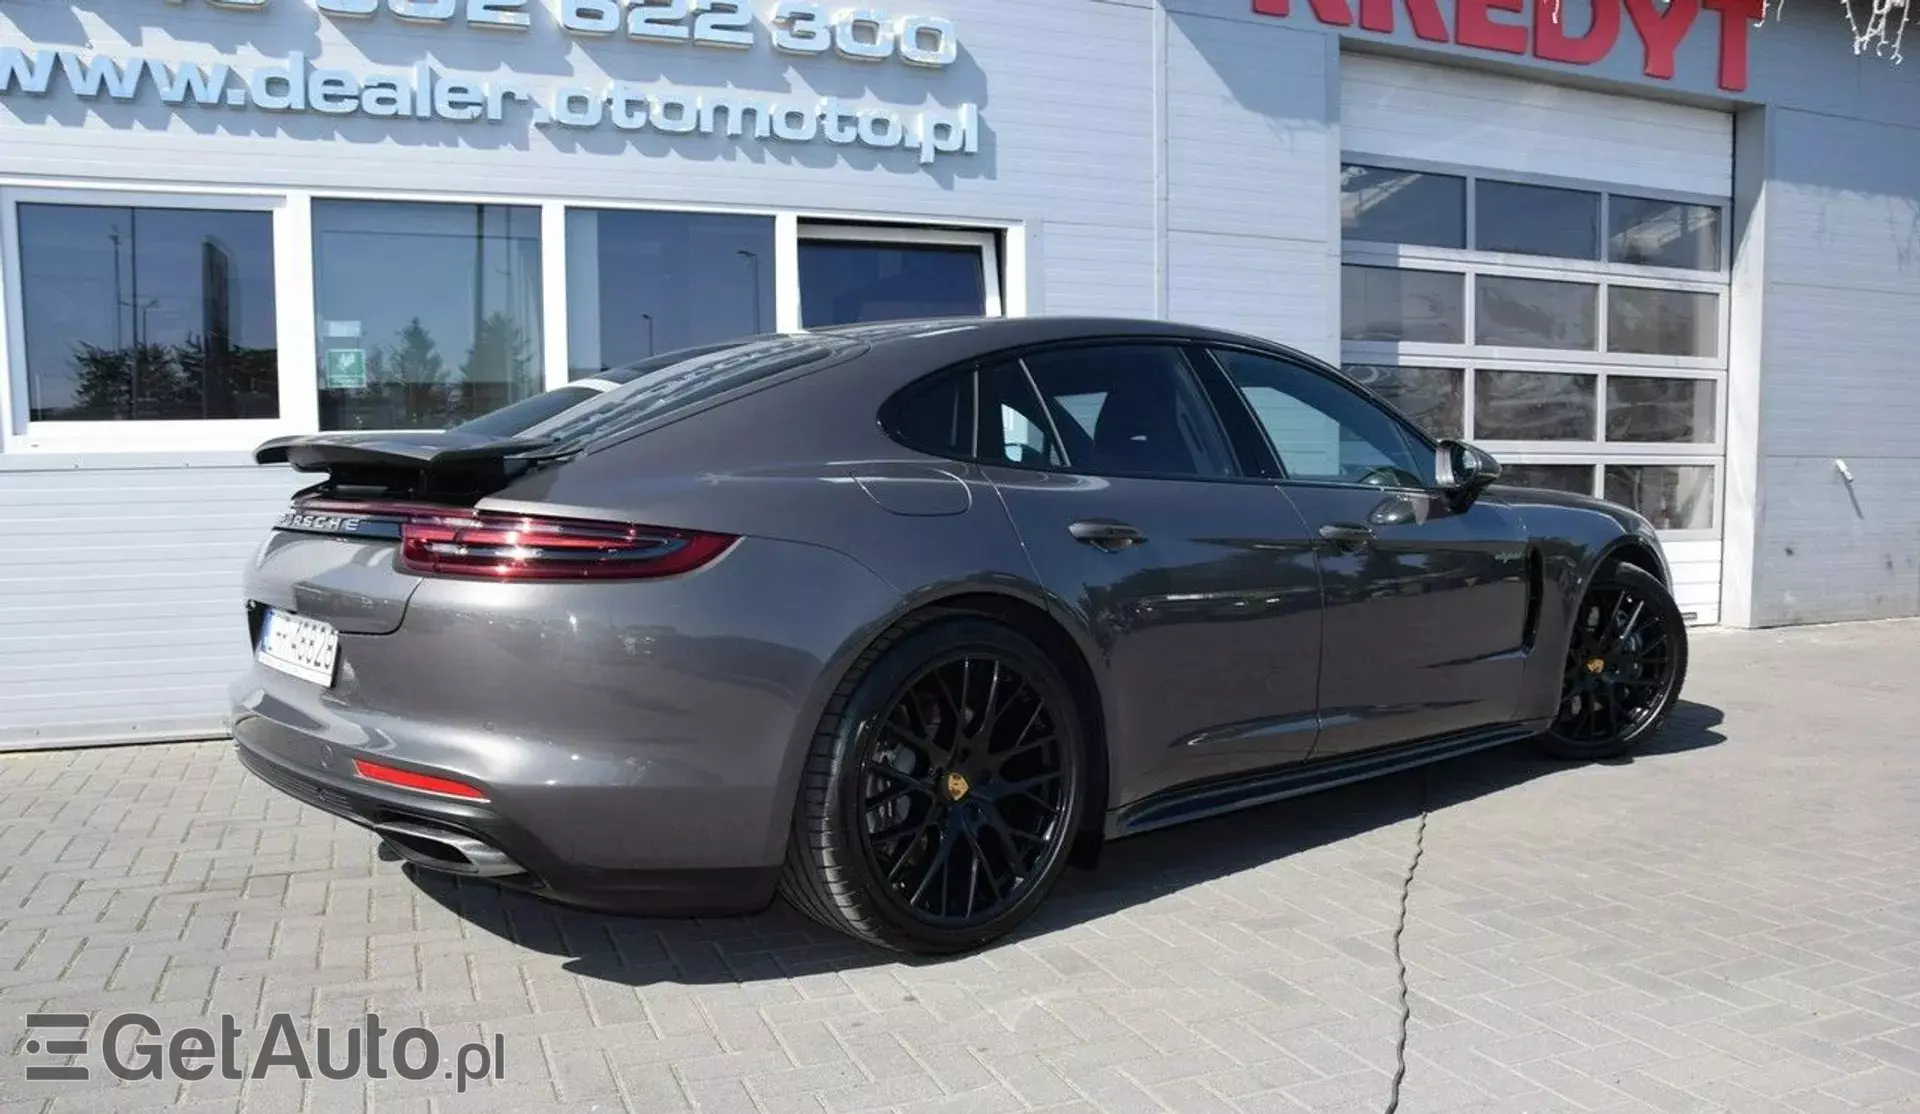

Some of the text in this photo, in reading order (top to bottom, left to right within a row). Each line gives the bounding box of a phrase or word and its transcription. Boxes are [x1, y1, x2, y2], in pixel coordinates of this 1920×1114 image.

[560, 0, 754, 48] 622
[768, 0, 958, 68] 300
[1254, 0, 1764, 92] EDYT
[279, 511, 360, 531] PORSCHE
